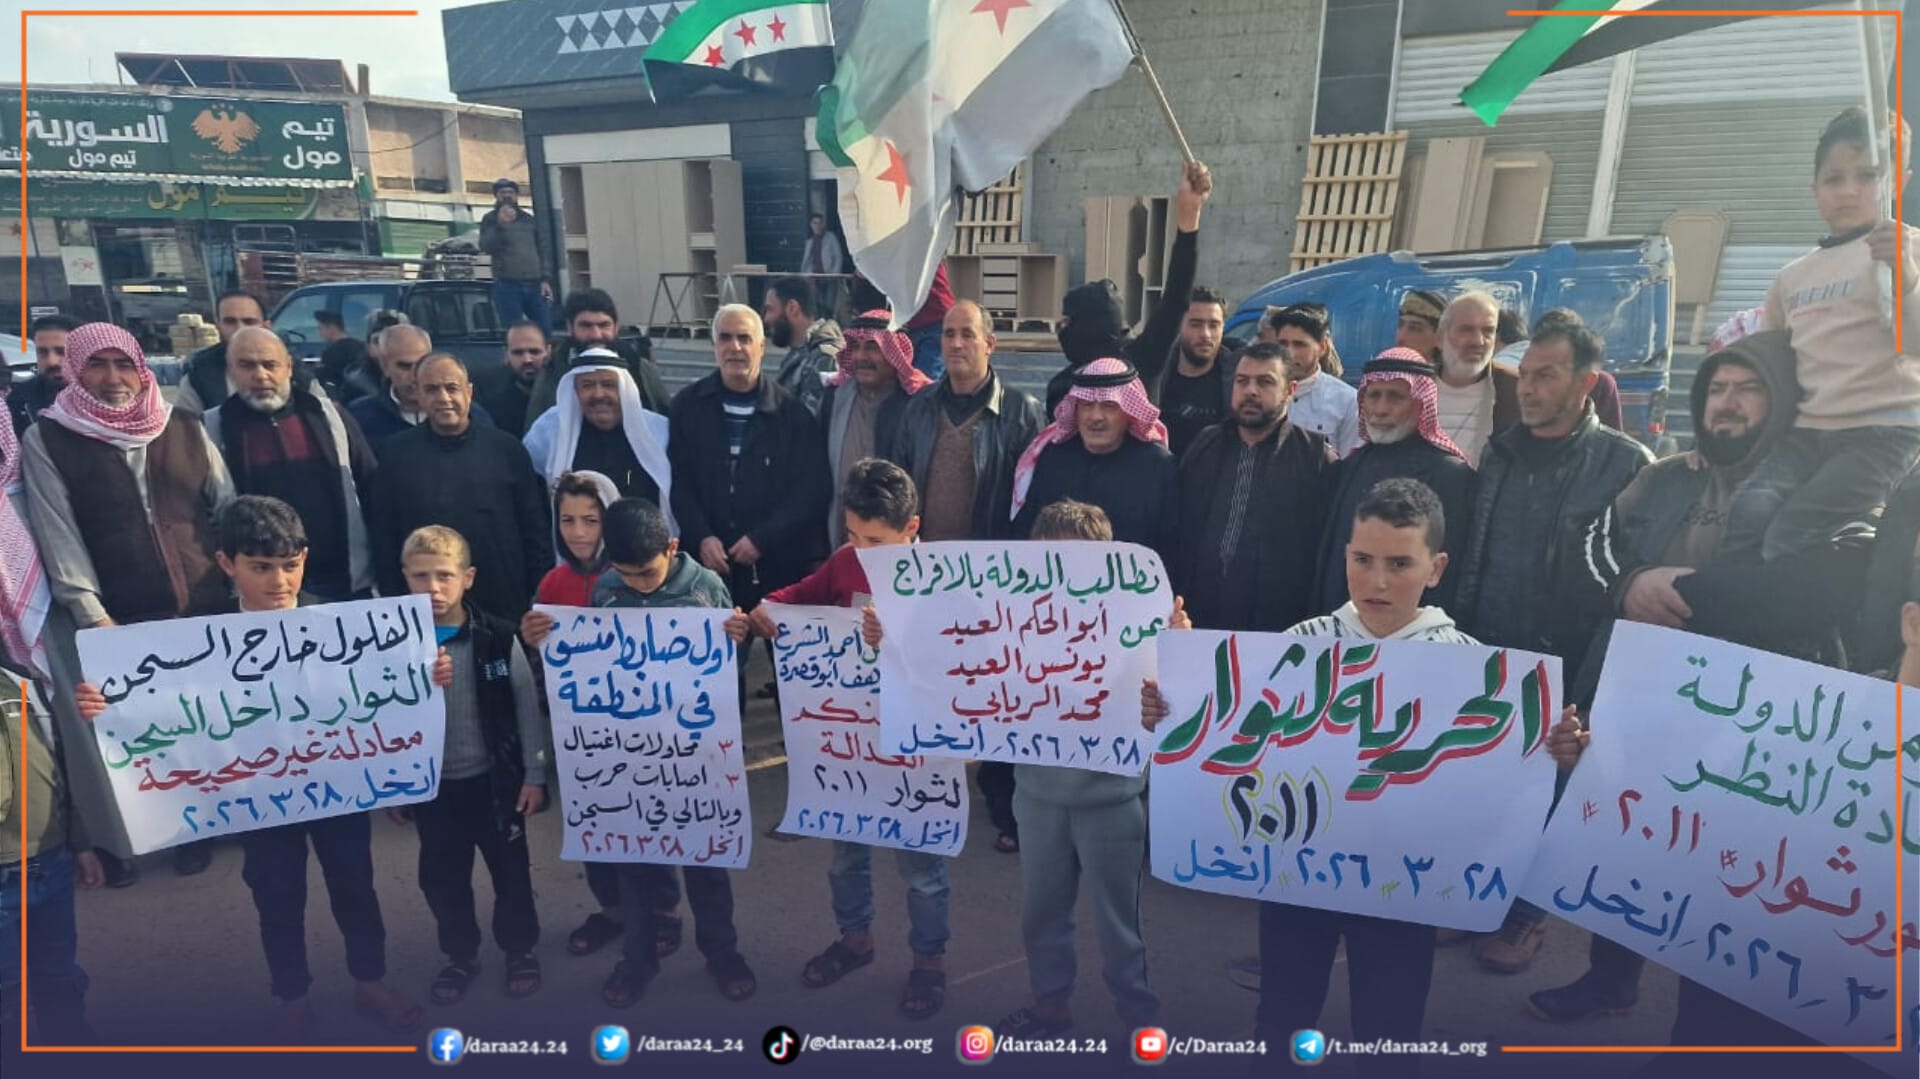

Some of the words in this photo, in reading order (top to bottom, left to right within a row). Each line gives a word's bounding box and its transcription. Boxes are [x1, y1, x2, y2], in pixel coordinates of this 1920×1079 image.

[26, 110, 169, 147] السورية
[282, 117, 336, 142] تيم
[69, 148, 106, 168] مول
[110, 150, 137, 169] تيم
[283, 145, 341, 171] مول
[987, 550, 1063, 595] الدولة
[1066, 553, 1160, 603] نطالب
[320, 605, 424, 667] الفلول
[940, 599, 1012, 645] العيد
[1019, 591, 1067, 647] الحكم
[100, 624, 231, 705] السجن
[232, 620, 319, 682] خارج
[946, 644, 1022, 686] العيد
[1025, 647, 1106, 684] يونس
[208, 682, 311, 741] داخل
[316, 662, 432, 726] الثوار
[557, 670, 674, 720] المنطقة
[676, 679, 716, 740] في
[1152, 633, 1341, 776] لثوار
[1676, 654, 1846, 743] الدولة
[104, 693, 207, 770] السجن
[326, 722, 423, 761] معادلة
[563, 725, 621, 757] اغتيال
[624, 731, 699, 759] محاولات
[1323, 643, 1552, 801] الحرية
[138, 744, 278, 793] صحيحة
[270, 729, 328, 778] غير
[575, 761, 628, 790] حرب
[1663, 737, 1835, 816] النظر
[813, 763, 868, 795] ٢٠١١
[885, 771, 961, 813] لثوار
[567, 792, 643, 828] السجن
[645, 794, 668, 831] في
[672, 796, 742, 830] وبالتالي
[1229, 772, 1320, 845] ٢٠١١
[1618, 788, 1702, 853] ٢٠١١
[1717, 836, 1861, 916] ثوار
